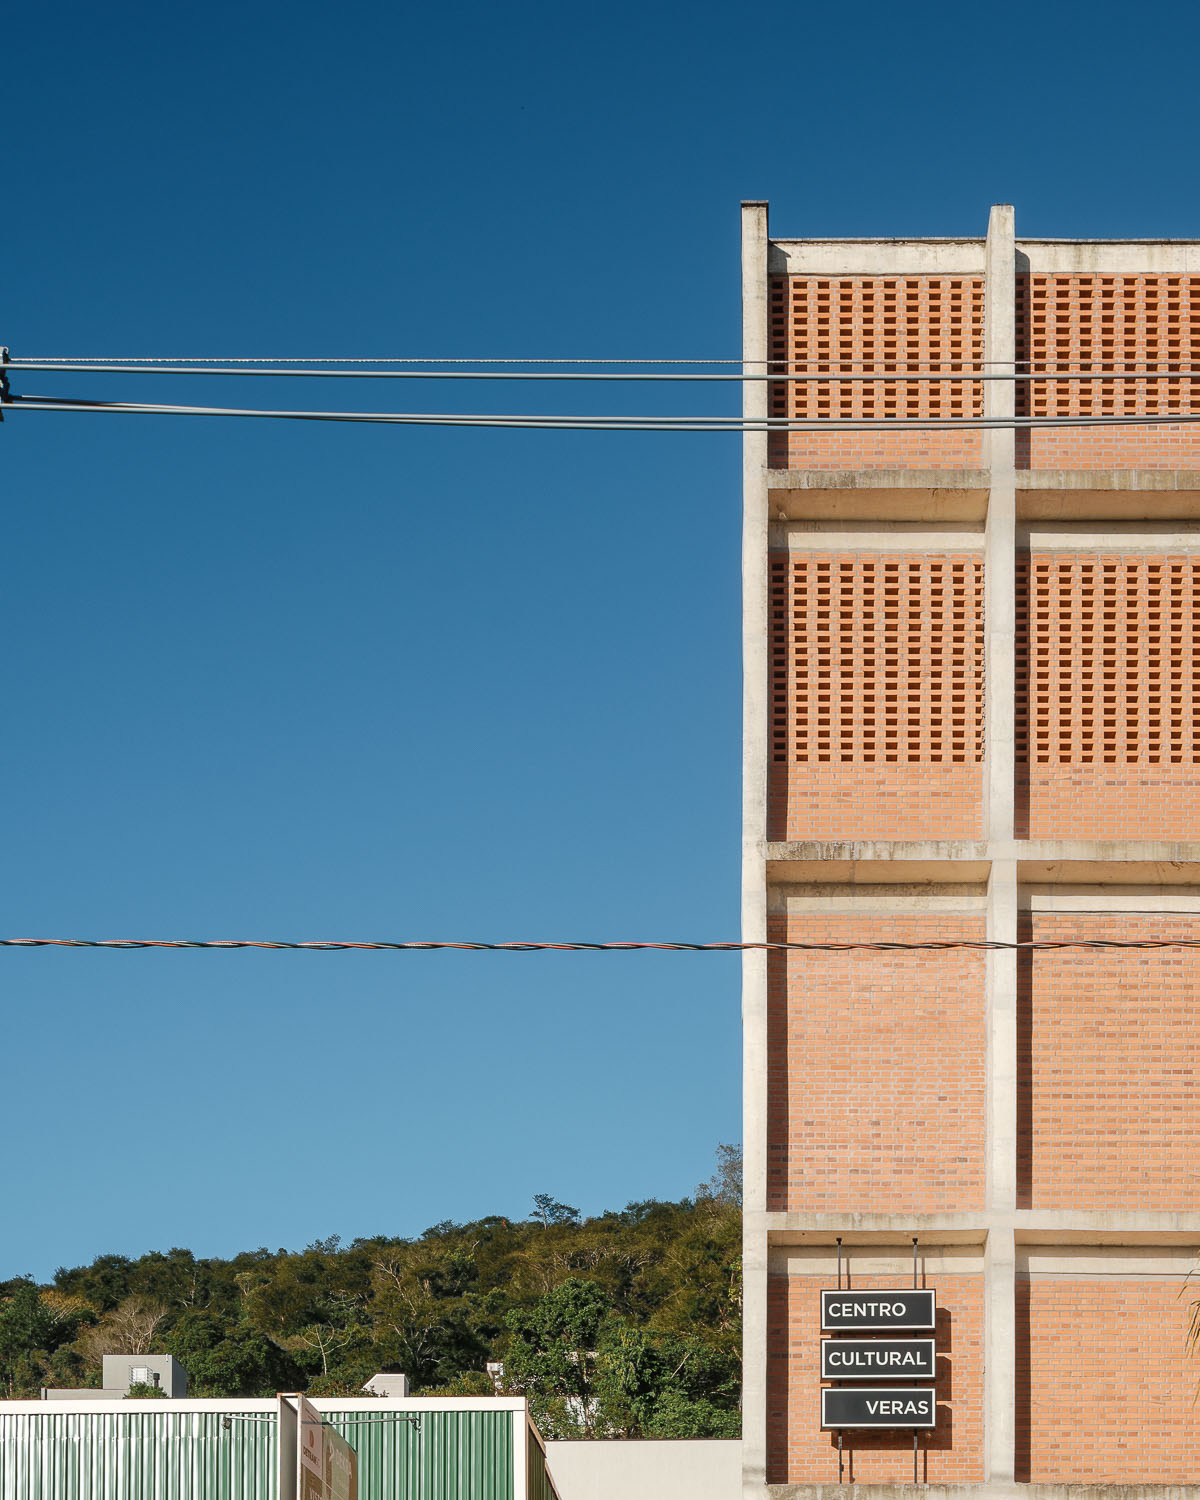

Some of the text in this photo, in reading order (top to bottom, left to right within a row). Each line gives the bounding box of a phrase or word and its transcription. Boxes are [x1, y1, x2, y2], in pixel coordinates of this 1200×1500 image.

[828, 1303, 906, 1317] CENTRO
[828, 1351, 927, 1366] CULTURAL
[866, 1400, 929, 1415] VERAS
